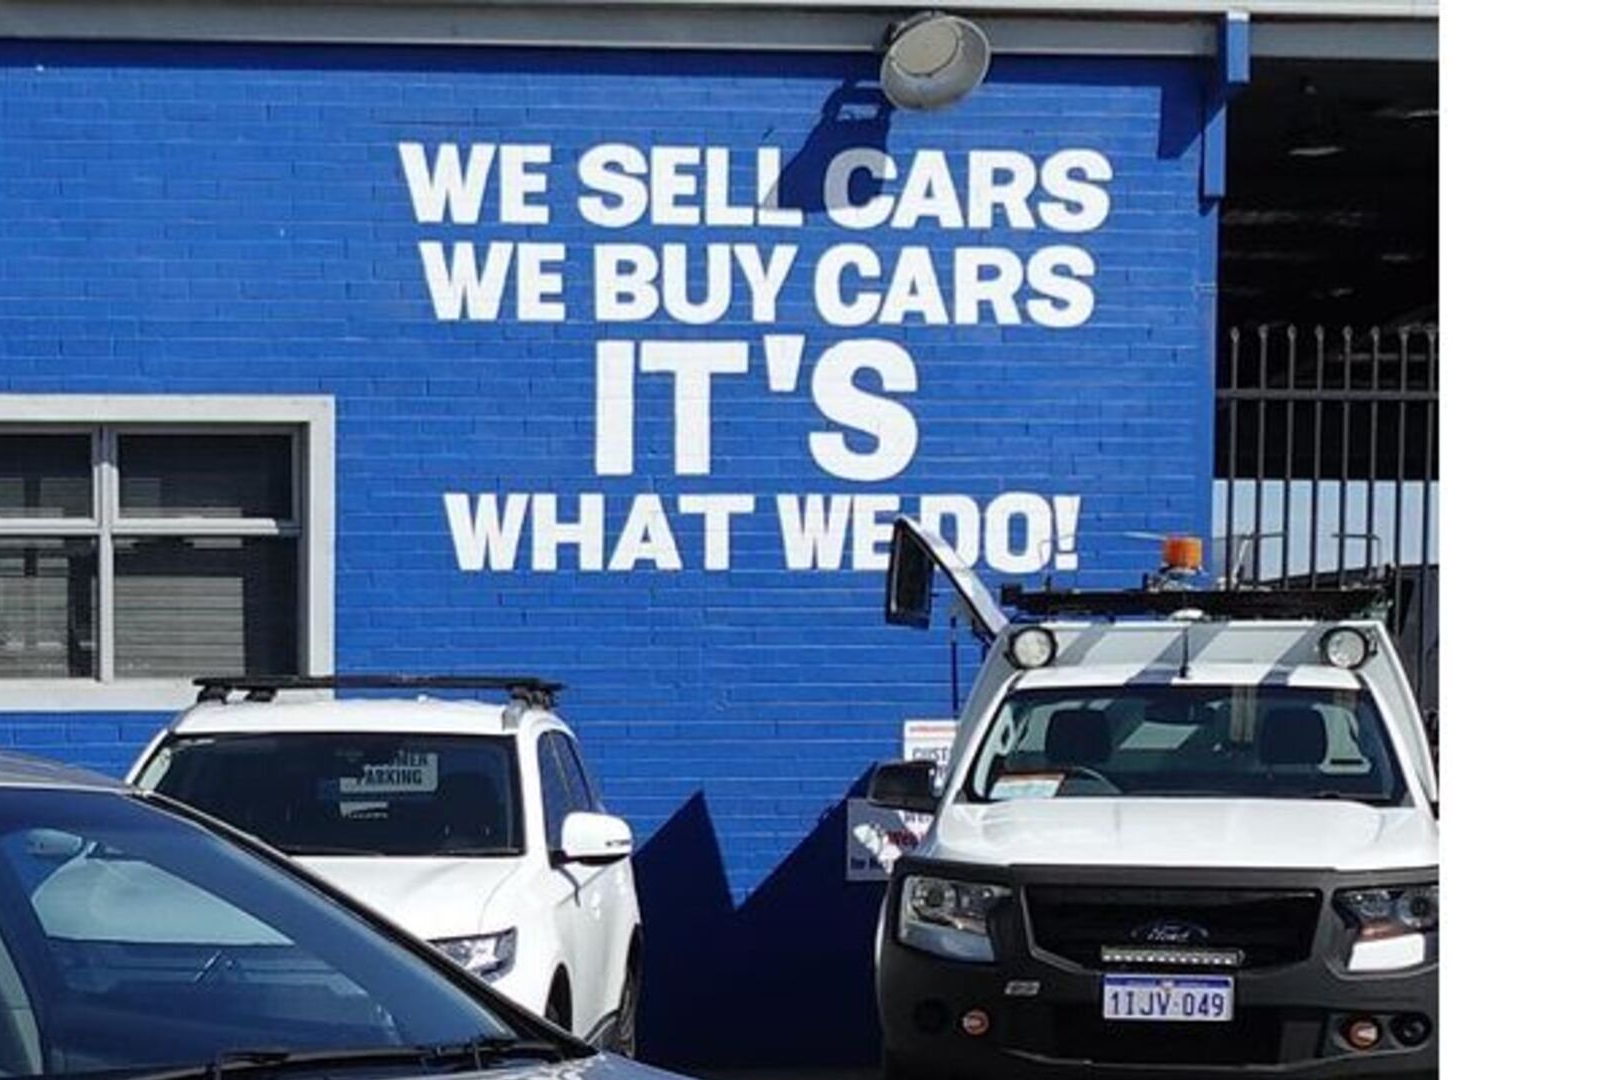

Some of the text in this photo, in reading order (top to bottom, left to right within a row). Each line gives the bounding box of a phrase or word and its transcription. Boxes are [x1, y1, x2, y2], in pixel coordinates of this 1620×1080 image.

[398, 142, 1113, 233] WE SELL CARS
[418, 241, 1095, 327] WE BUY CARS
[593, 333, 919, 481] IT'S
[443, 491, 1082, 573] WHAT WE DO!
